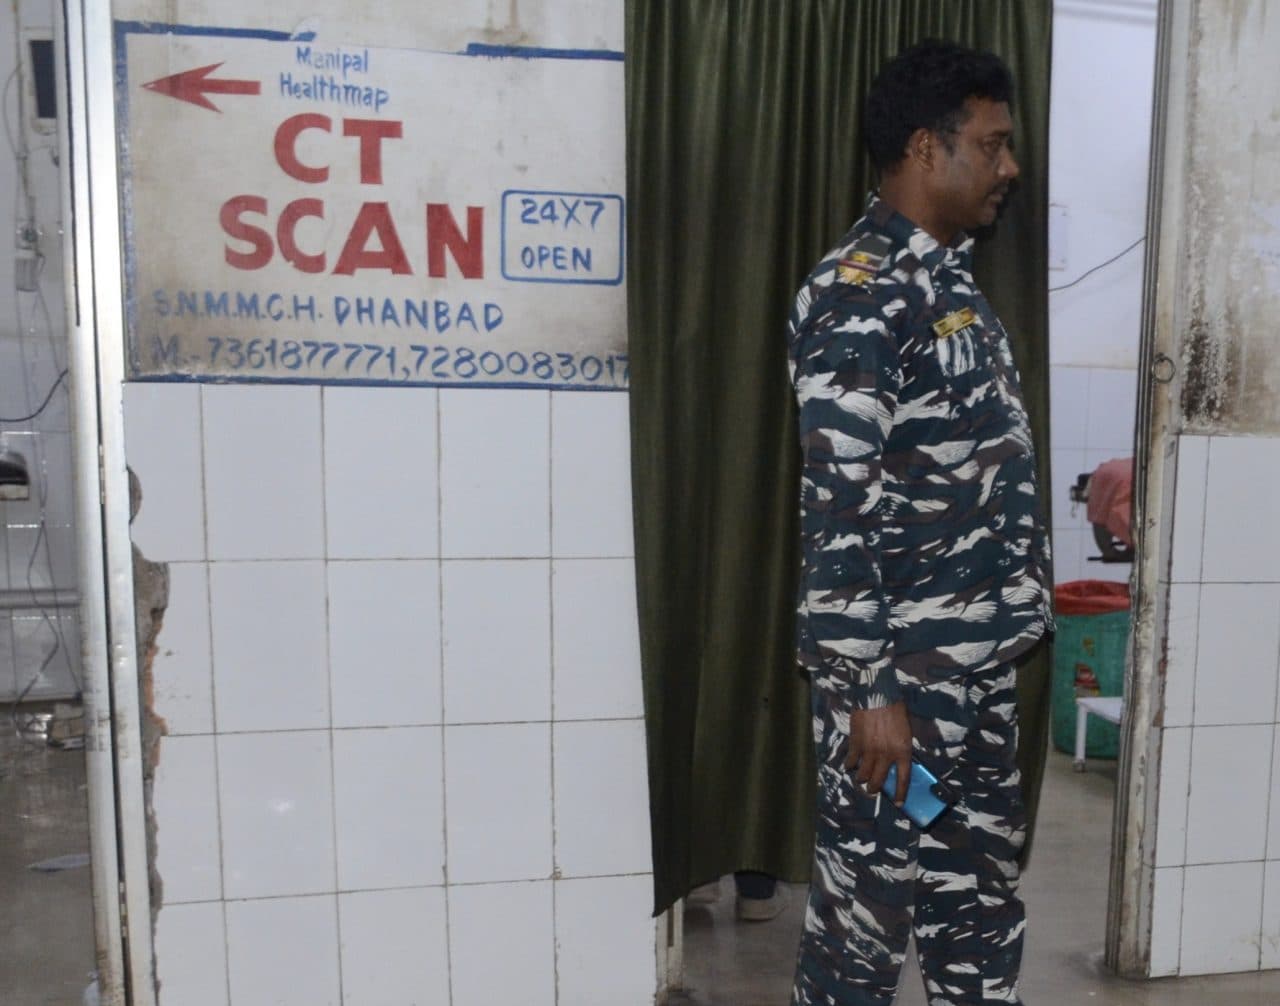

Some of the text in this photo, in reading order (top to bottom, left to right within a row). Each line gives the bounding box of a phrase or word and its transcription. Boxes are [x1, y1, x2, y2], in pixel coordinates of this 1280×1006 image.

[295, 46, 369, 80] Manipal
[279, 71, 391, 113] Healthmap
[273, 112, 403, 185] CT
[519, 198, 607, 229] 24X7
[218, 195, 485, 280] SCAN
[520, 246, 593, 273] OPEN
[335, 296, 503, 333] DHANBAD
